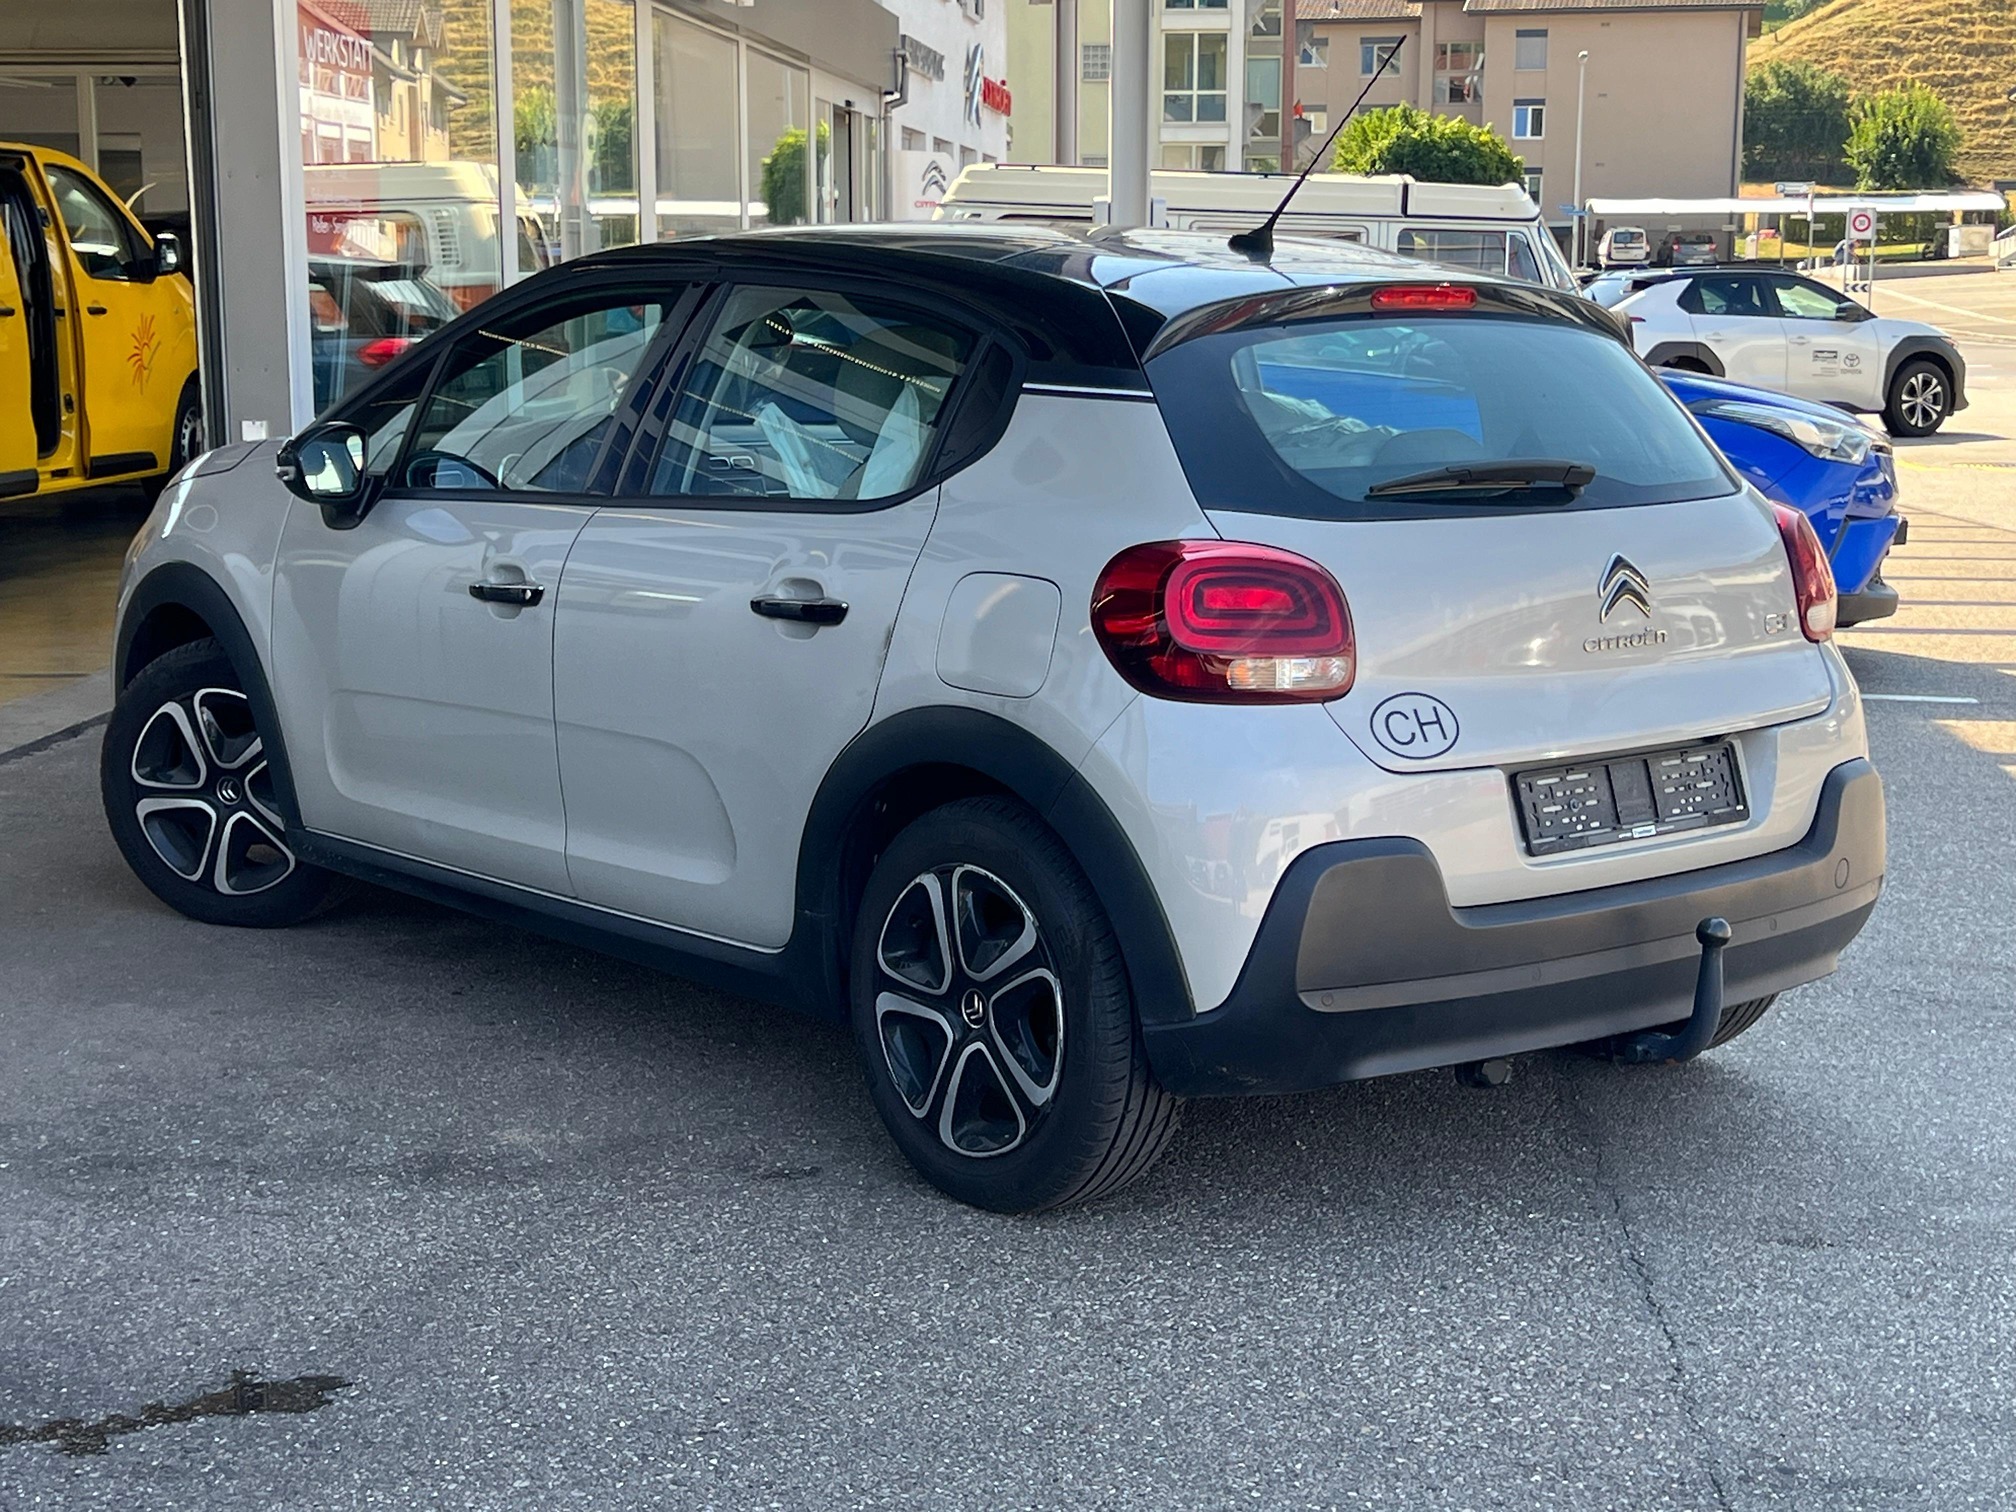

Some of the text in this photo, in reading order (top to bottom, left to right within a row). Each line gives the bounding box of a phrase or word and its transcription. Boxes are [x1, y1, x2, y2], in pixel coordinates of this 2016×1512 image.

[302, 25, 374, 73] WERKSTATT
[1583, 626, 1668, 653] CITROËN
[1385, 706, 1448, 746] CH
